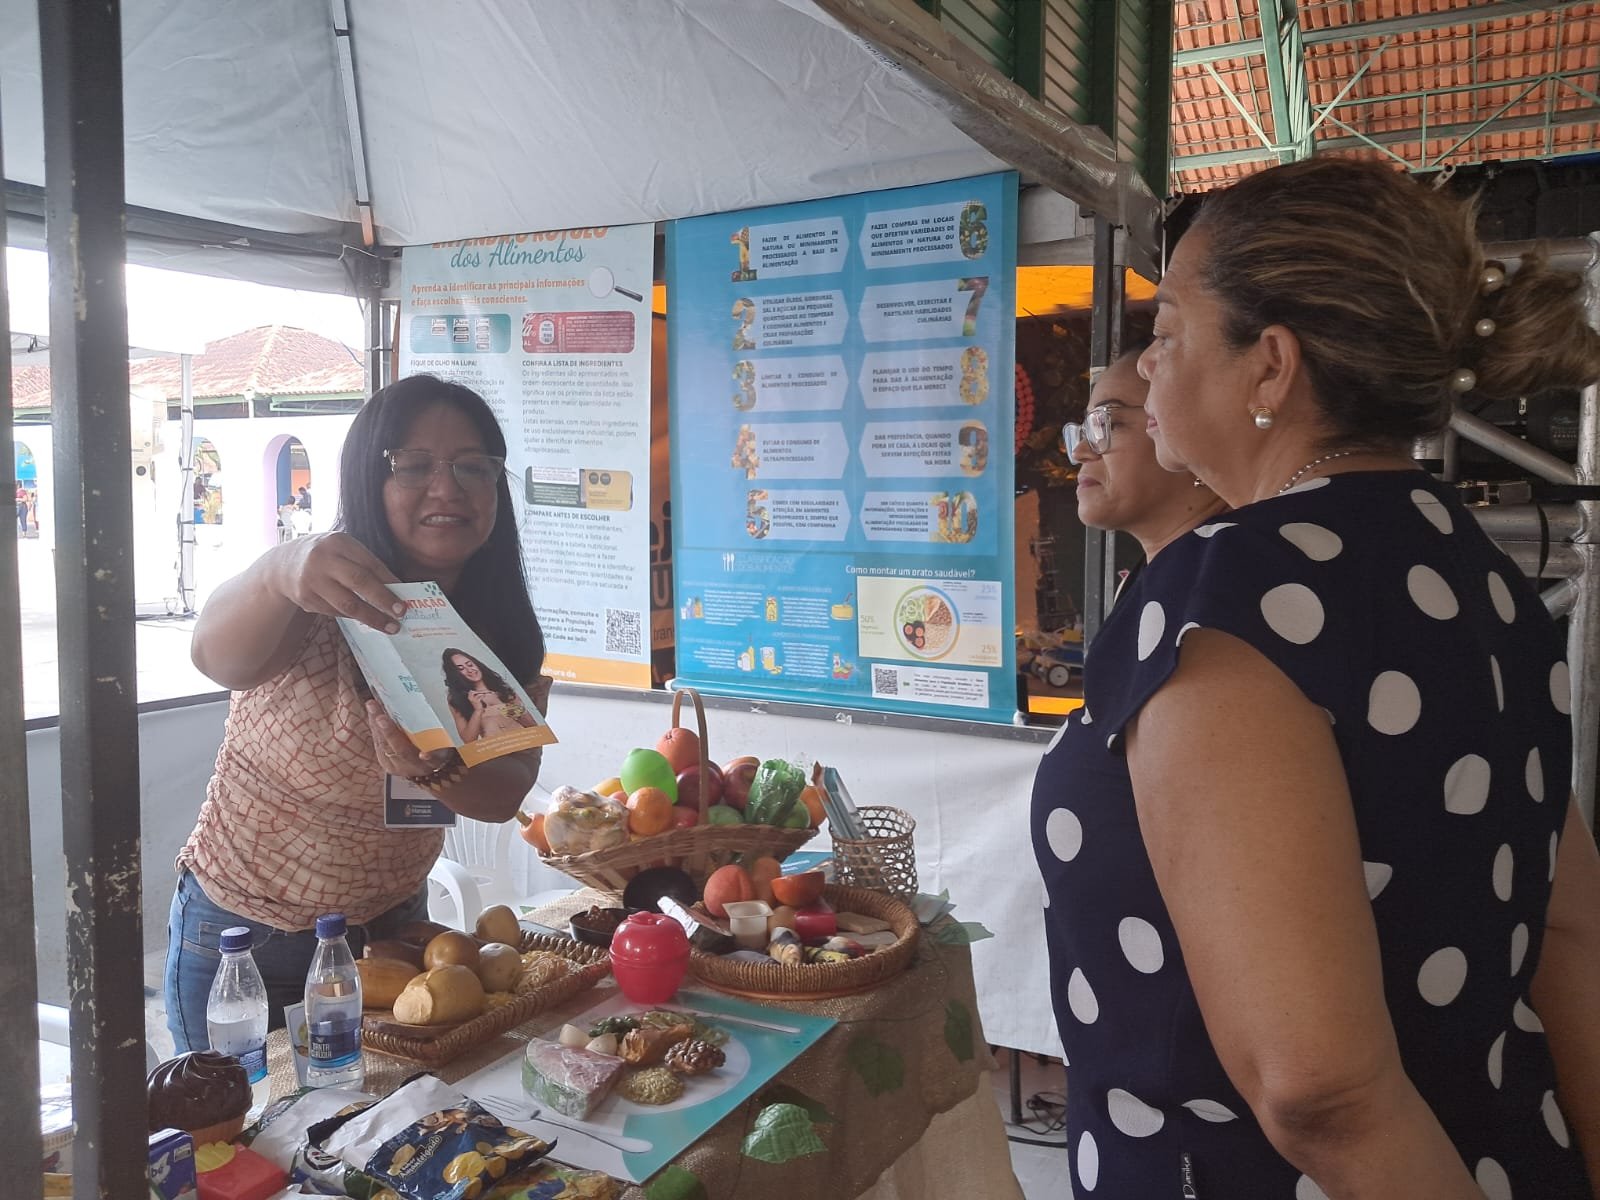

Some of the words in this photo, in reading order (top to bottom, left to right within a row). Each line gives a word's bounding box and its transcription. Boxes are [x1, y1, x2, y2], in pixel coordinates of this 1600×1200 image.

[892, 220, 918, 228] COMPRAS
[934, 216, 954, 224] LOCAIS
[911, 226, 945, 235] VARIEDADES
[800, 239, 838, 247] MINIMAMENTE
[872, 240, 903, 248] ALIMENTOS
[451, 244, 481, 268] dos
[489, 239, 586, 268] Alimentos
[872, 247, 911, 256] MINIMAMENTE
[913, 244, 953, 253] PROCESSADOS
[762, 252, 797, 260] PROCESSADOS
[762, 259, 798, 268] ALIMENTAÇÃO
[412, 283, 441, 294] Aprenda
[450, 282, 485, 291] identificar
[499, 281, 534, 292] principais
[537, 277, 585, 289] informações
[915, 307, 952, 315] HABILIDADES
[580, 513, 610, 521] ESCOLHER
[846, 565, 867, 574] Como
[869, 567, 896, 576] montar
[934, 568, 975, 578] saudável?
[405, 596, 447, 610] NTAÇÃO
